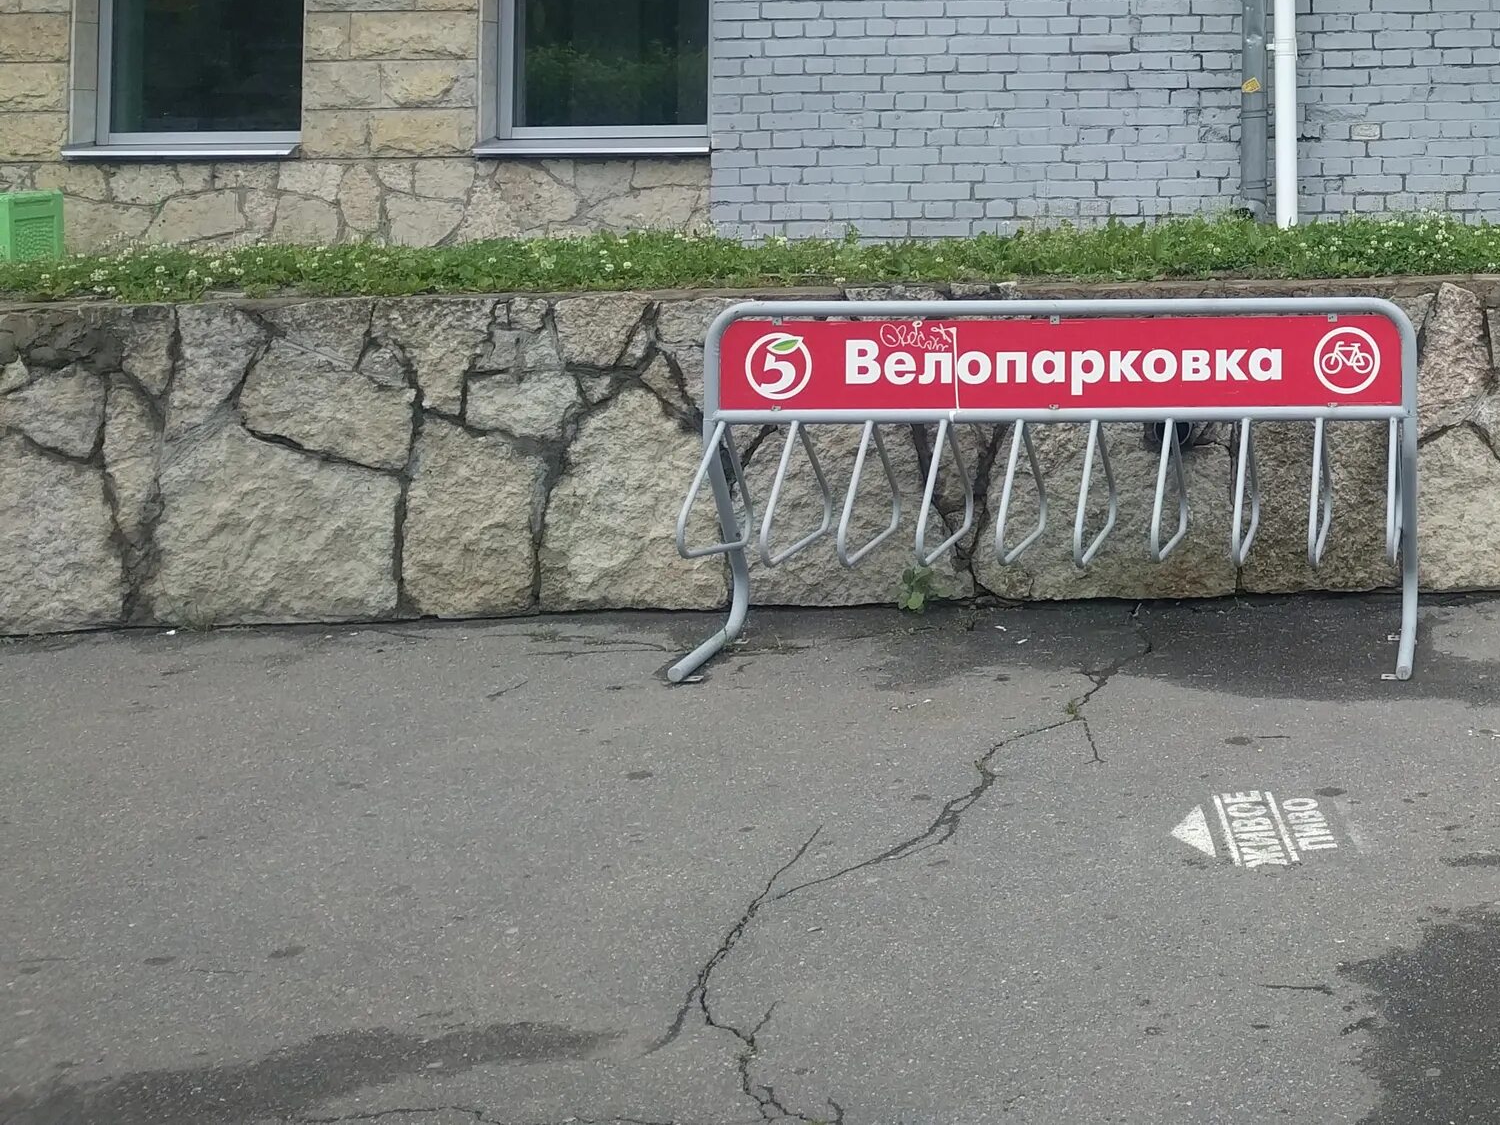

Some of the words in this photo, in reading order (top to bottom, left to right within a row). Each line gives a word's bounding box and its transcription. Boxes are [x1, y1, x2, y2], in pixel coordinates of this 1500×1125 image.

[845, 339, 1283, 395] Велопарковка
[1221, 790, 1289, 868] ЖИВОЕ
[1282, 797, 1338, 851] ПИВО
